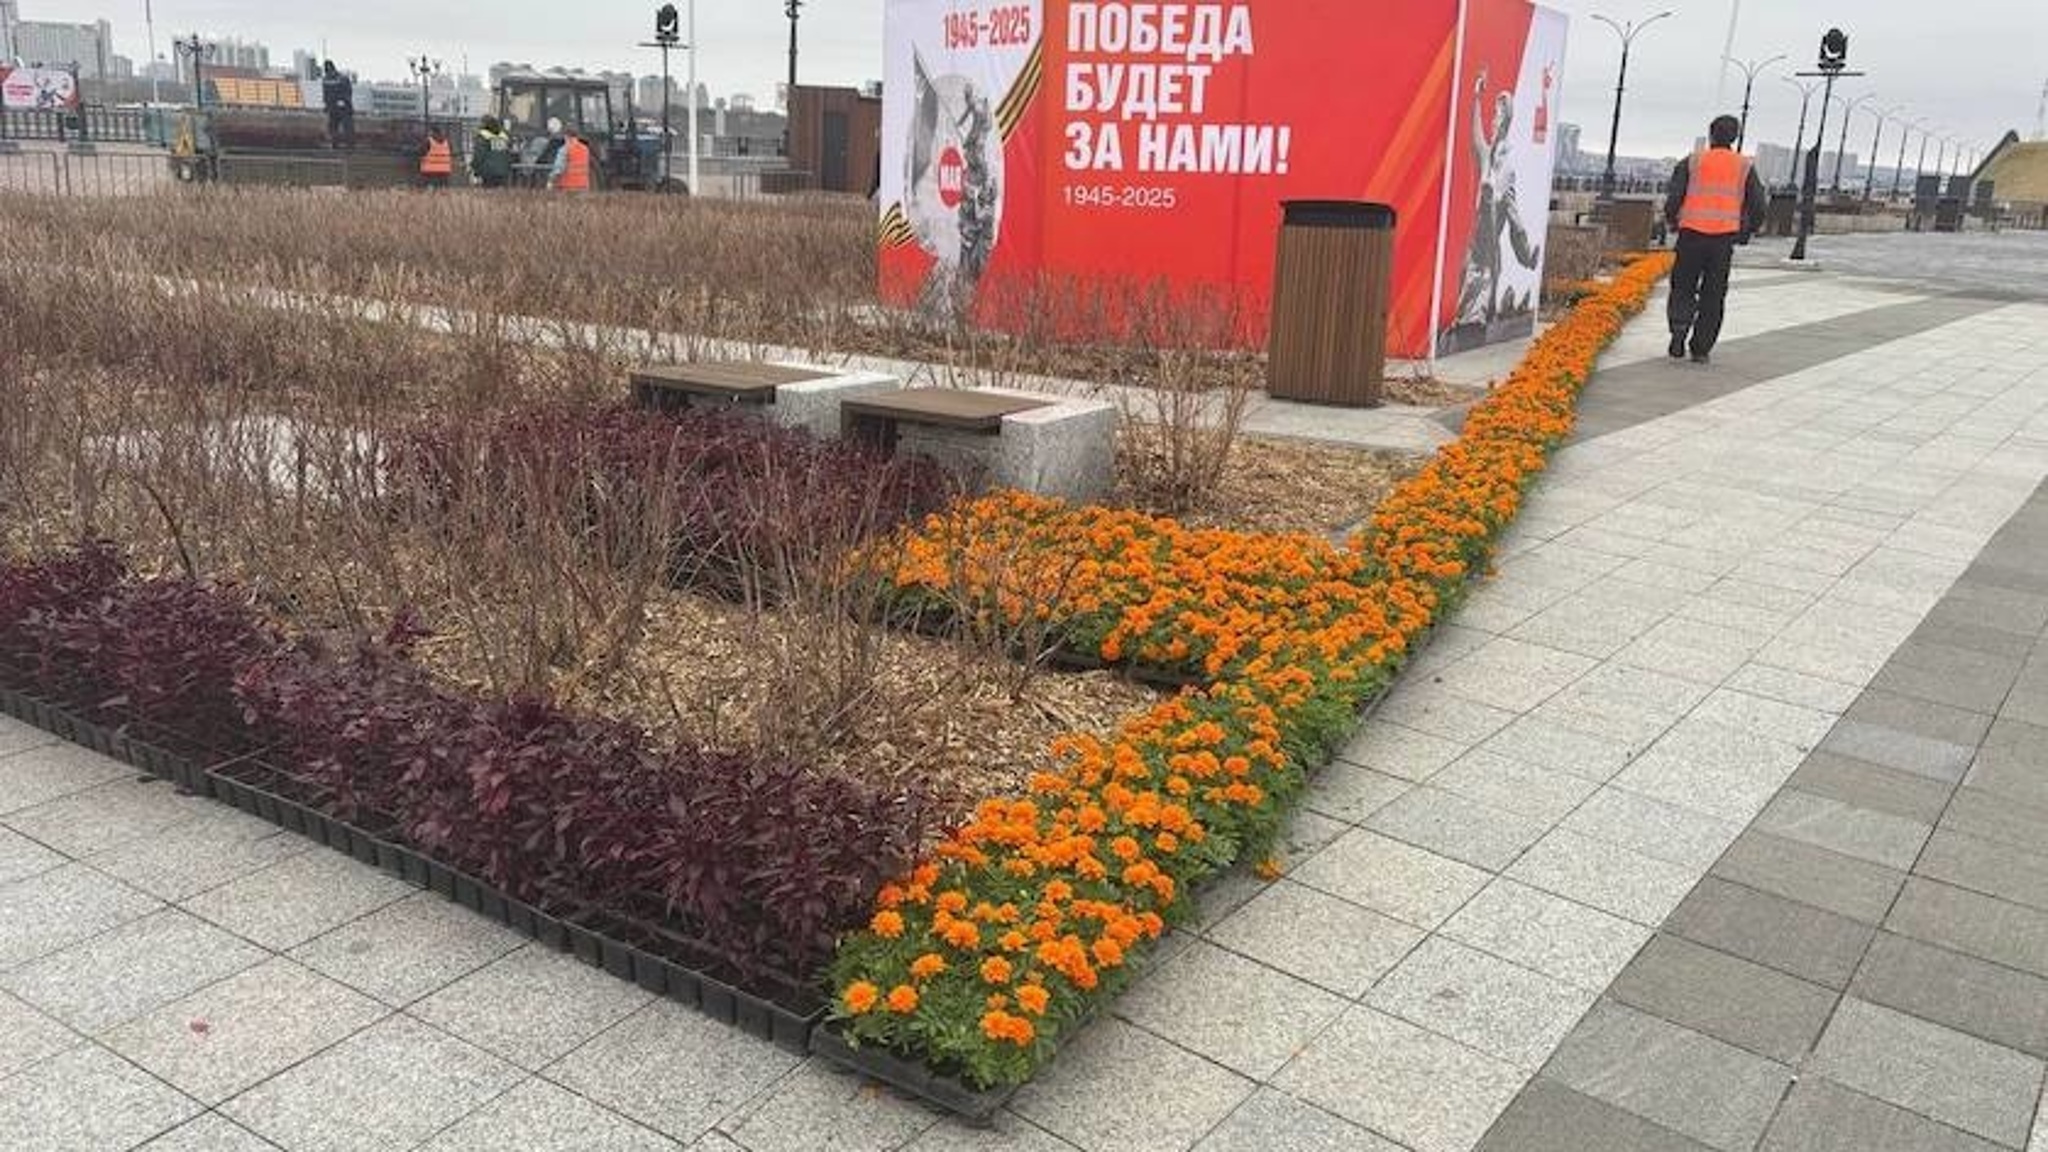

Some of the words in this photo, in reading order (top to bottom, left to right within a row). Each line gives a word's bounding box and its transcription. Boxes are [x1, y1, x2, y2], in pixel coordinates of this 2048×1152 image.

[1067, 3, 1253, 62] ПОБЕДА
[1065, 63, 1212, 119] БУДЕТ
[1065, 122, 1122, 171] ЗА
[1138, 125, 1290, 174] НАМИ!
[1064, 186, 1176, 208] 1945-2025
